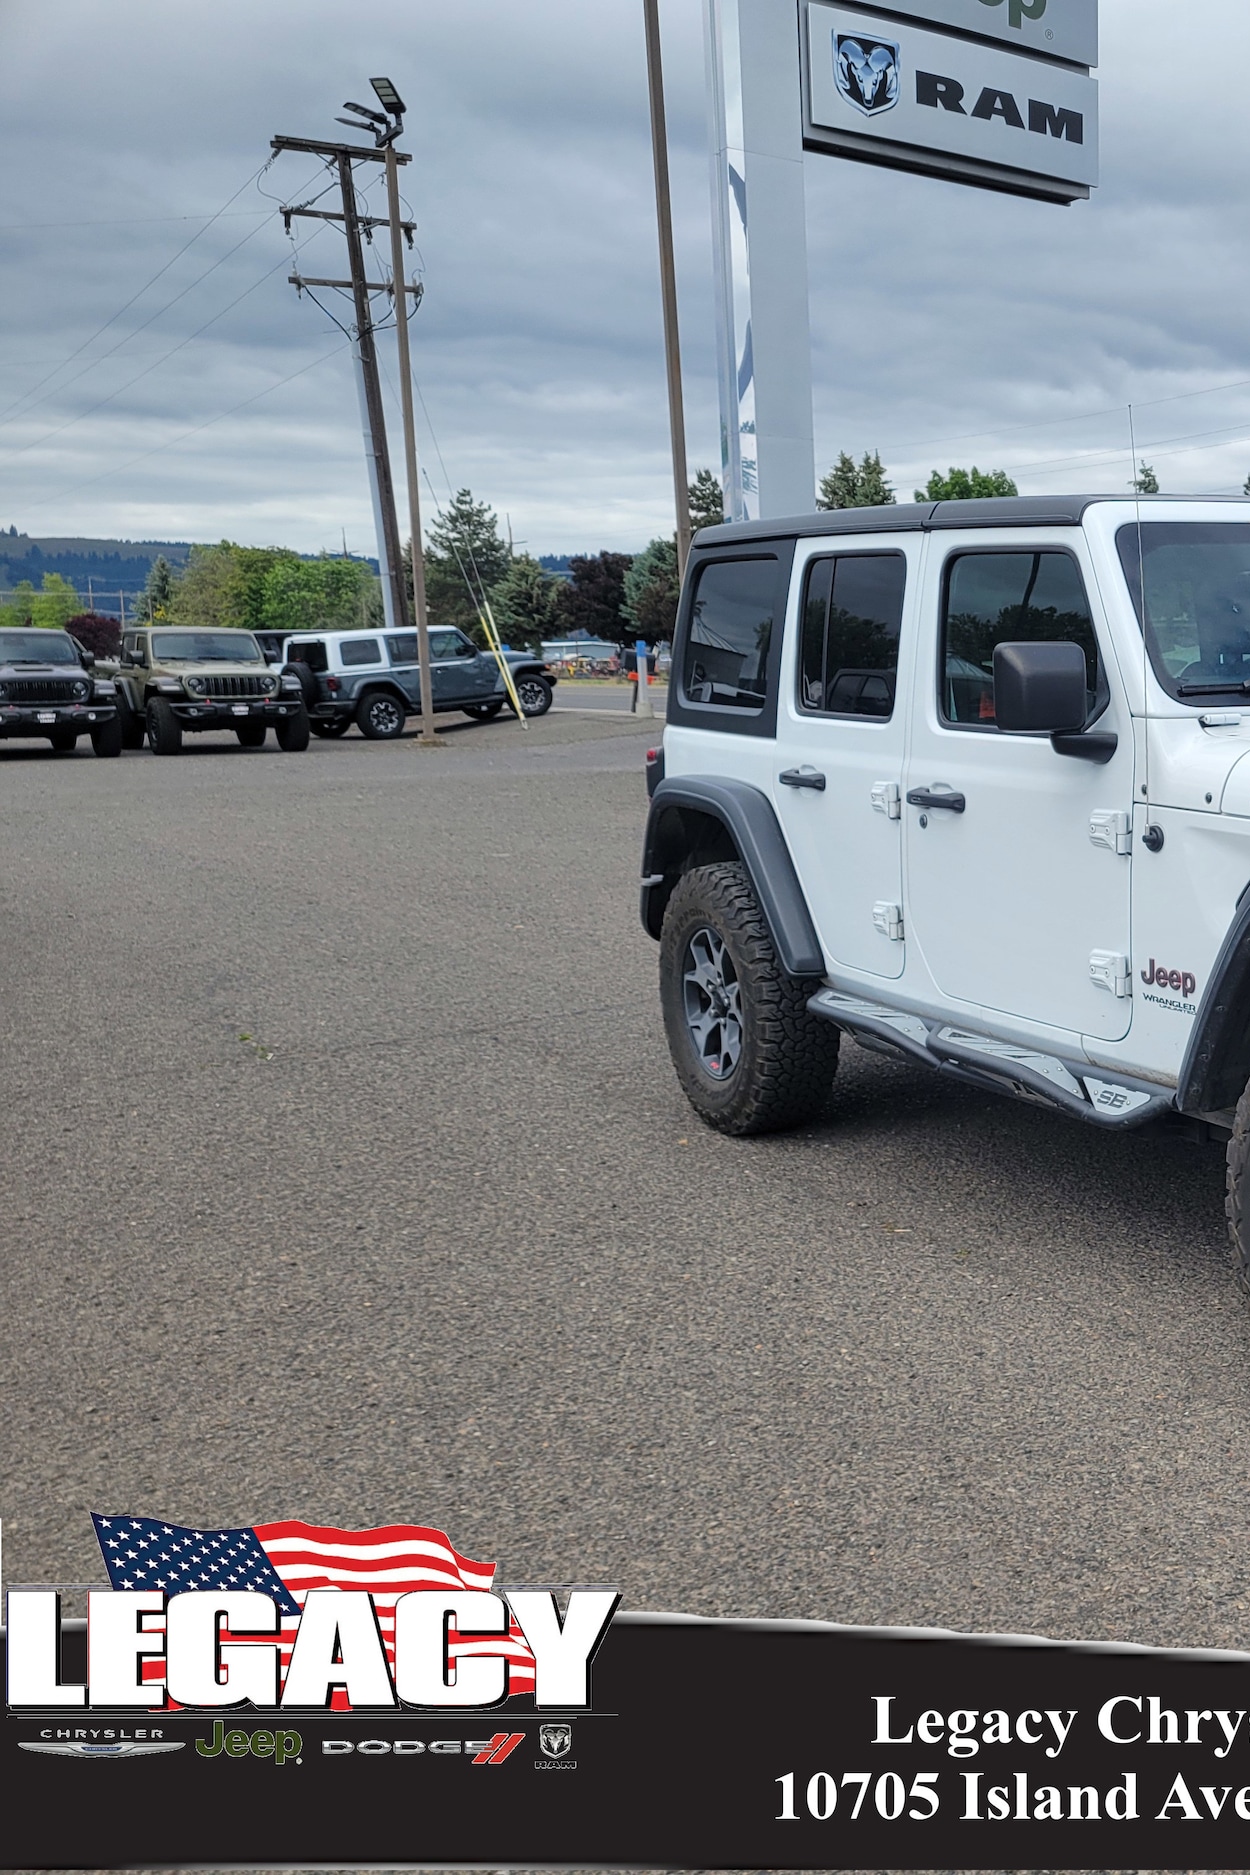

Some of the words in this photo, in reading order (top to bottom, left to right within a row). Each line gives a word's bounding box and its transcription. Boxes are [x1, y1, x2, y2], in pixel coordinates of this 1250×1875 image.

[915, 69, 1083, 145] RAM
[1140, 957, 1197, 999] Jeep
[1142, 992, 1197, 1012] WRANGLER
